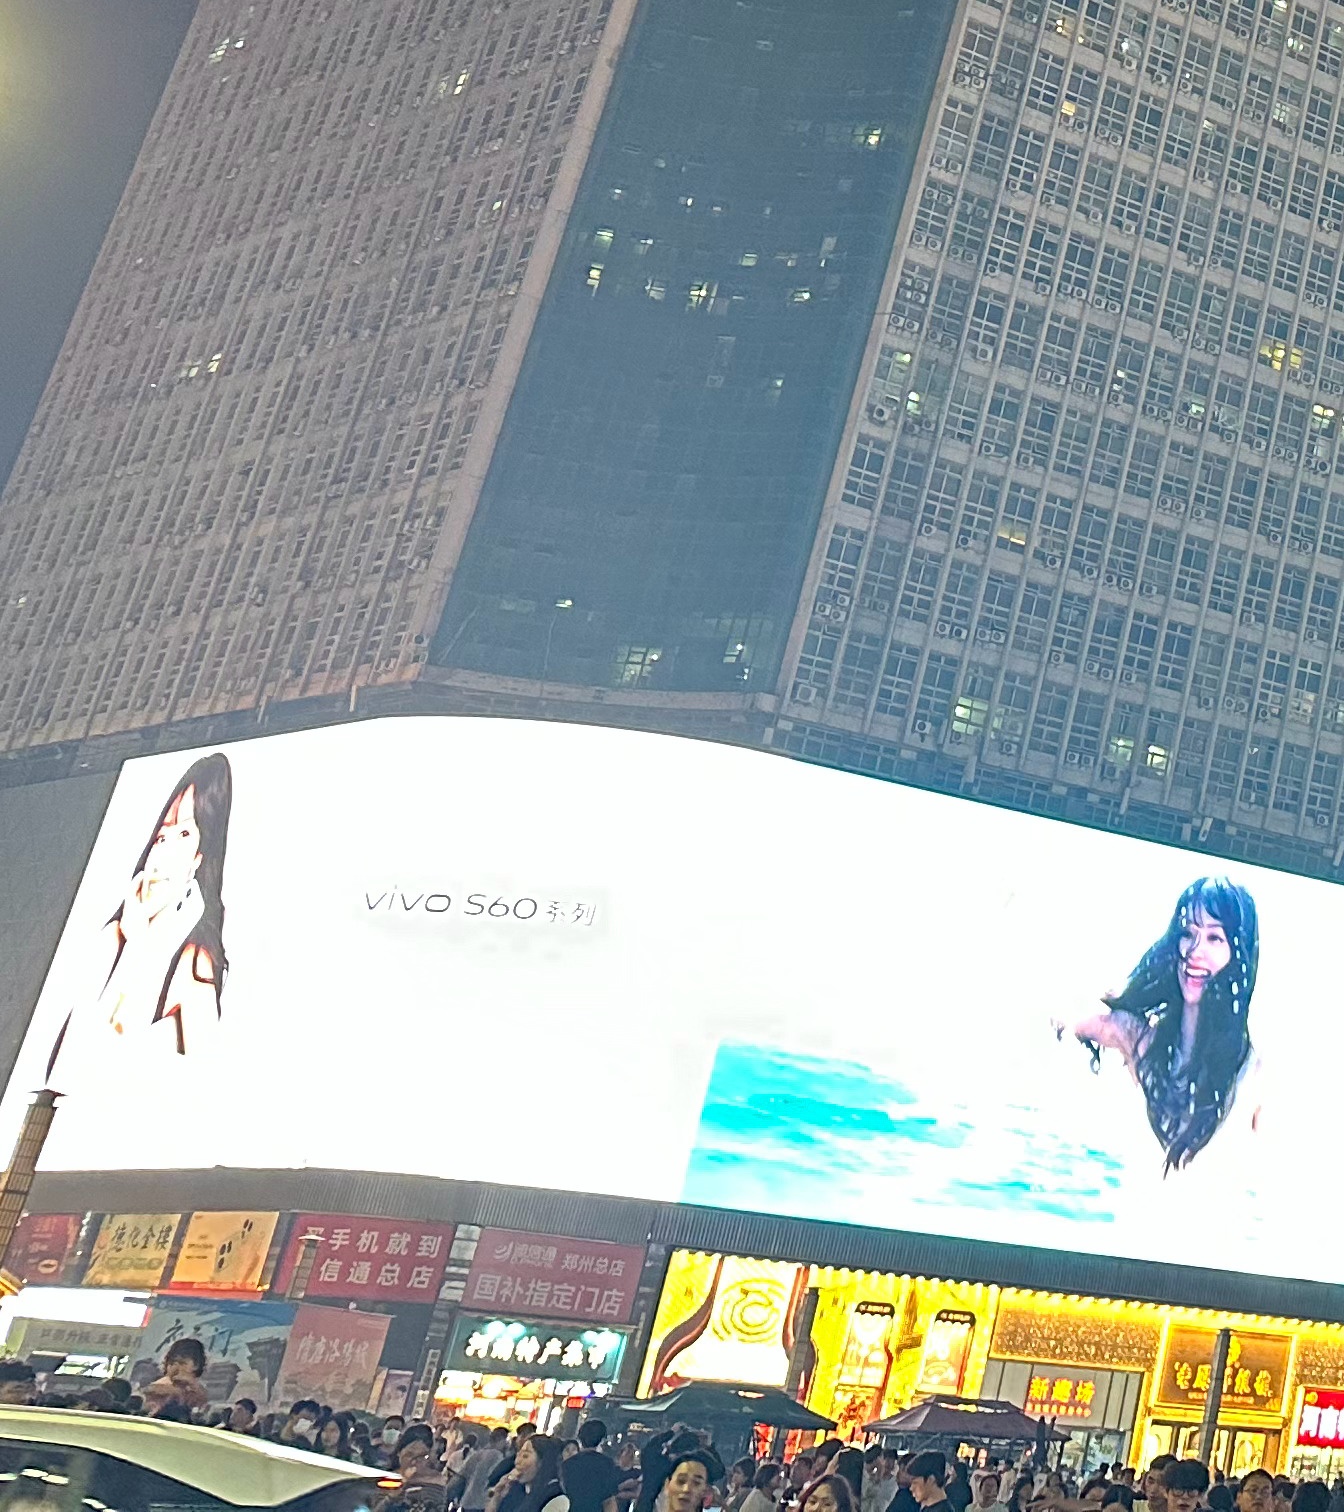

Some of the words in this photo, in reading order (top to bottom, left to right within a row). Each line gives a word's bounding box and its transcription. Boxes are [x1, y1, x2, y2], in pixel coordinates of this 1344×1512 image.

[366, 885, 451, 912] vivo
[464, 894, 537, 919] S60
[546, 899, 596, 926] 系列
[317, 1258, 434, 1289] 信通总店
[561, 1253, 626, 1276] 郑州总店
[473, 1273, 625, 1316] 国补指定门店
